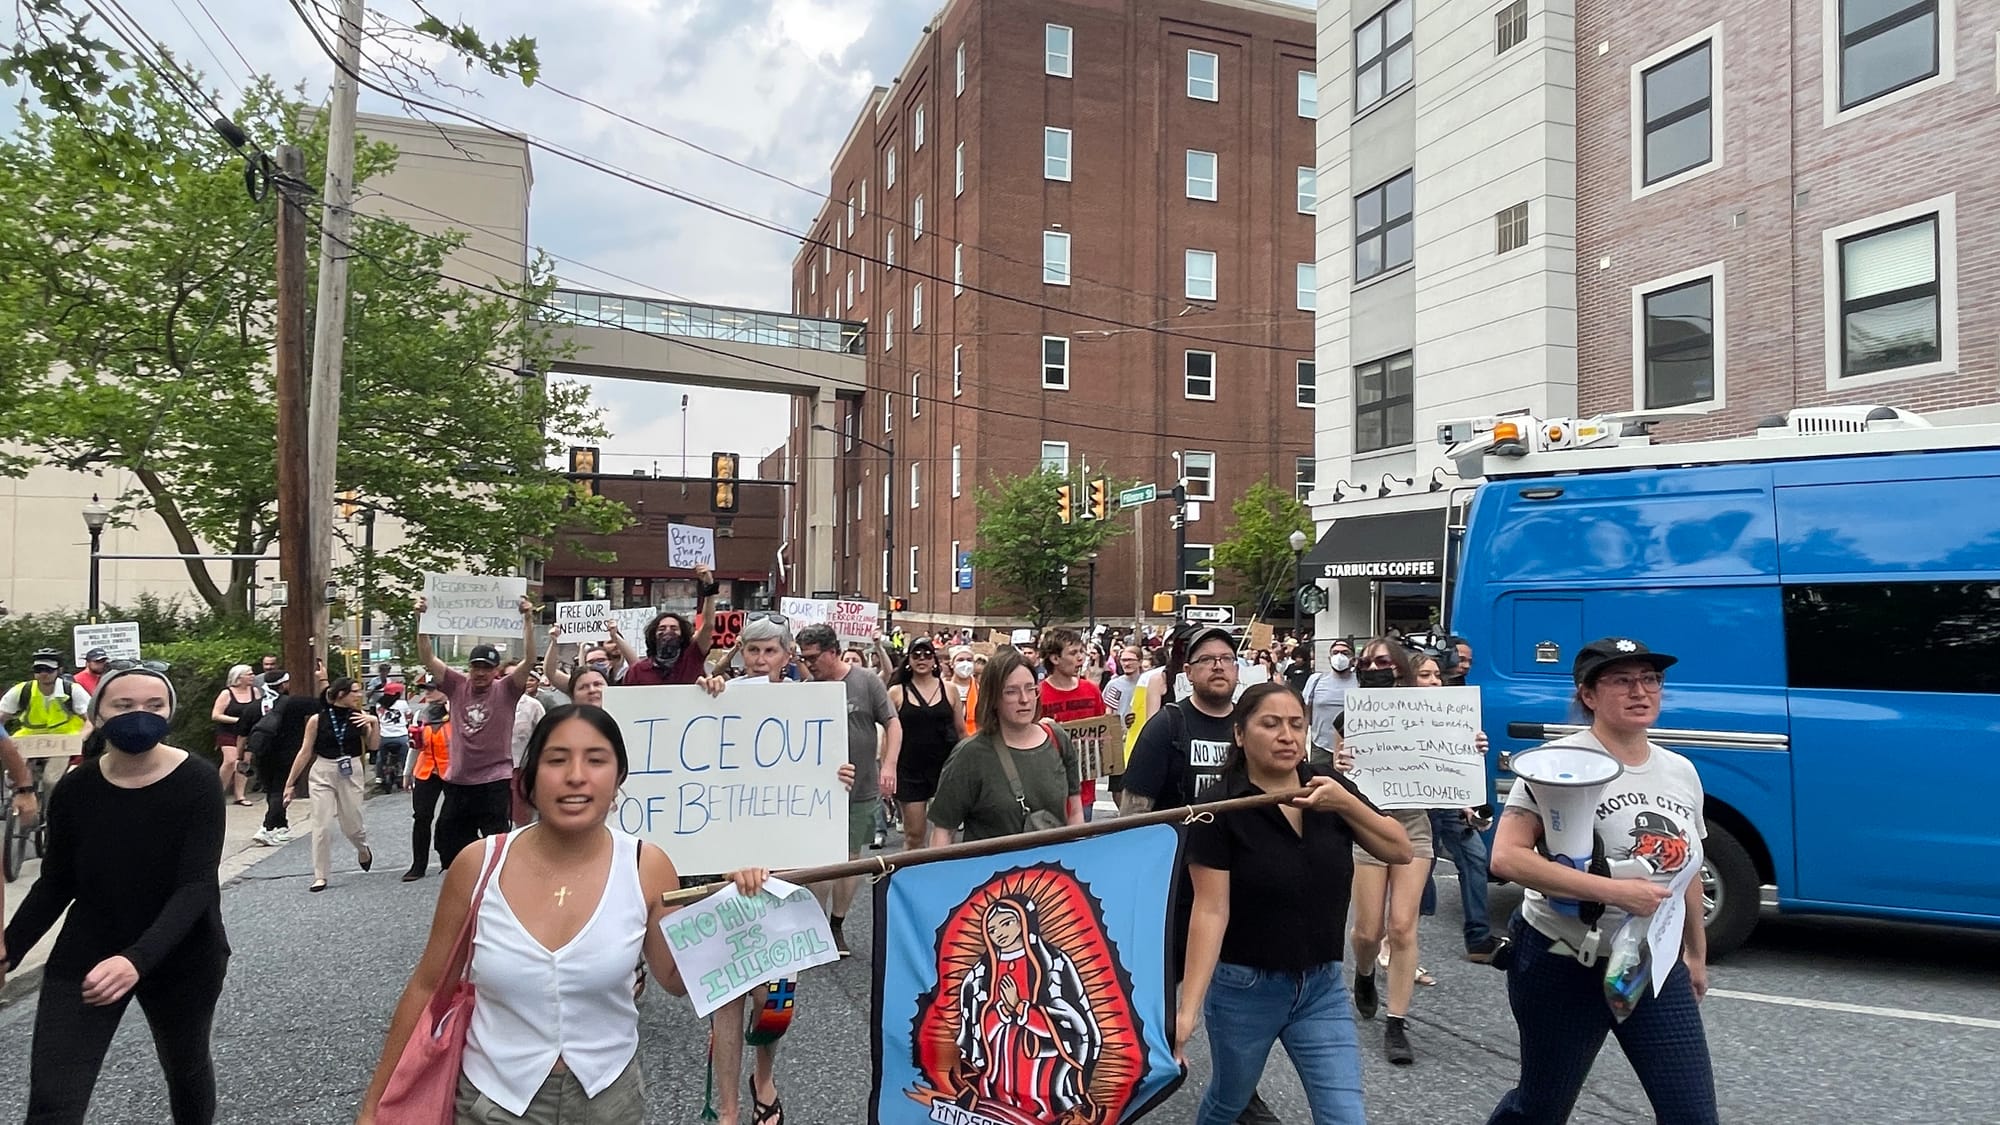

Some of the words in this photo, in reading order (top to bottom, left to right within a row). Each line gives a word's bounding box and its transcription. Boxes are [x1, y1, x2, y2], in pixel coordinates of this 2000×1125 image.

[670, 527, 706, 550] Bring
[1324, 564, 1387, 577] STARBUCKS
[1388, 561, 1435, 575] COFFEE
[560, 606, 582, 618] FREE
[585, 604, 604, 617] OUR
[828, 612, 876, 623] TERRORIZING
[837, 602, 864, 615] STOP
[560, 620, 609, 634] NEIGHBORS
[711, 633, 738, 649] IC
[1346, 694, 1443, 712] Undocumented
[1347, 715, 1396, 732] CANNOT
[1401, 719, 1424, 731] get
[754, 717, 835, 768] OUT
[1376, 742, 1415, 752] blame
[1416, 739, 1476, 756] IMMIGRA
[1193, 743, 1208, 762] NO
[1364, 765, 1394, 776] you
[1382, 781, 1471, 801] BILLIONAIRES
[619, 796, 666, 835] OF
[673, 782, 832, 835] BETHLEHEM
[1595, 792, 1649, 821] MOTOR
[1656, 796, 1691, 821] CITY
[666, 911, 717, 951] NO
[725, 924, 767, 961] IS
[700, 928, 830, 1003] ILLEGAL
